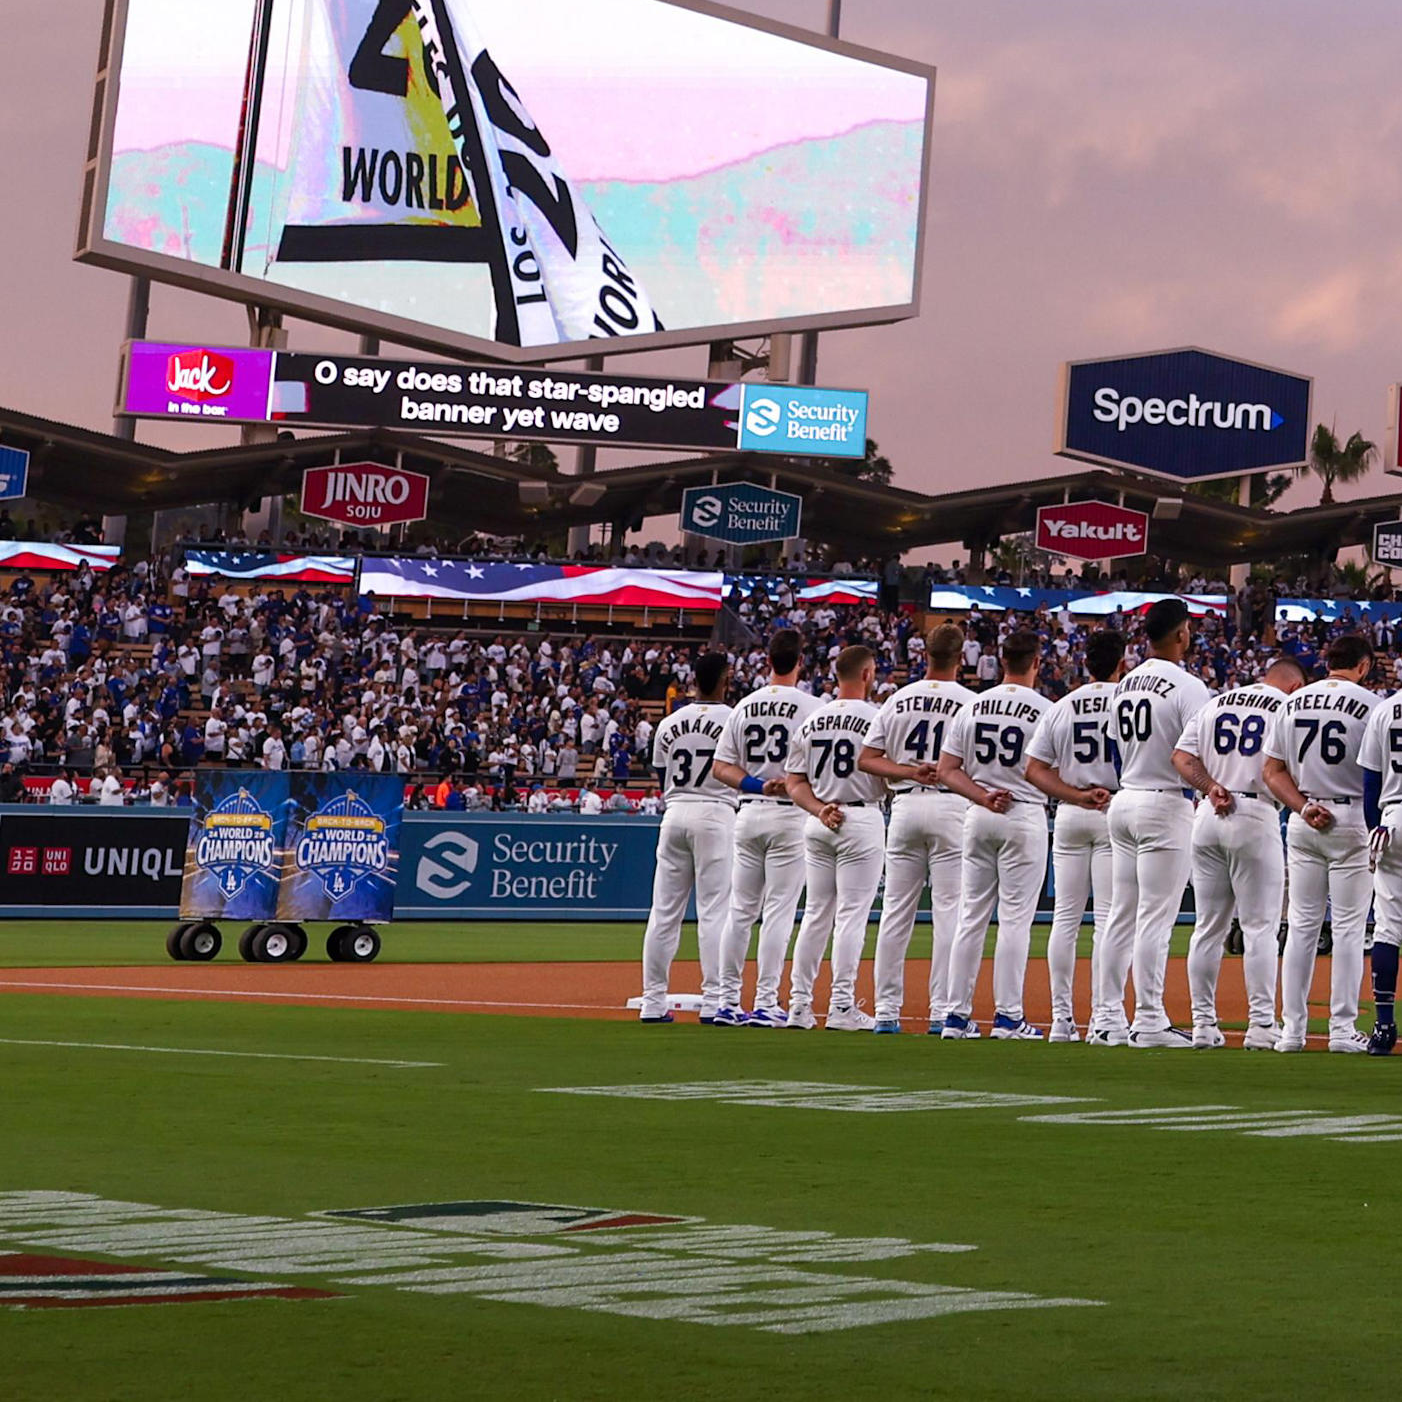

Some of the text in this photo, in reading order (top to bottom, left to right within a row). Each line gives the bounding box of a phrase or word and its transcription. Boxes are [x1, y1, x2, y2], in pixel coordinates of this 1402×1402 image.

[342, 146, 471, 211] WORLD
[168, 355, 230, 395] Jack
[315, 361, 705, 412] O say does that star-spangled
[401, 397, 620, 433] banner yet wave
[787, 400, 860, 424] Security
[1093, 387, 1272, 431] Spectrum
[320, 470, 410, 509] JINRO
[346, 504, 382, 519] SOJU
[727, 497, 791, 518] Security
[727, 513, 781, 532] Benefit
[1043, 519, 1142, 542] Yakult
[744, 700, 799, 720] TUCKER
[896, 697, 963, 717] STEWART
[972, 699, 1041, 723] PHILLIPS
[1118, 698, 1152, 742] 60
[1217, 694, 1281, 715] RUSHING
[1286, 694, 1370, 721] FREELAND
[802, 714, 871, 737] CASPARIUS
[905, 719, 942, 761] 41
[1213, 712, 1266, 757] 68
[744, 724, 789, 763] 23
[974, 722, 1025, 767] 59
[1073, 720, 1112, 764] 51
[1294, 718, 1347, 765] 76
[672, 748, 716, 788] 37
[811, 739, 855, 779] 78
[219, 827, 253, 840] WORLD
[325, 829, 365, 842] WORLD
[45, 861, 68, 872] QLO
[46, 851, 67, 860] UNI
[84, 847, 183, 876] UNIQL
[198, 836, 273, 867] CHAMPIONS
[298, 839, 385, 870] CHAMPIONS
[492, 833, 618, 871] Security
[490, 869, 597, 899] Benefit
[328, 1250, 1109, 1334] WEEK
